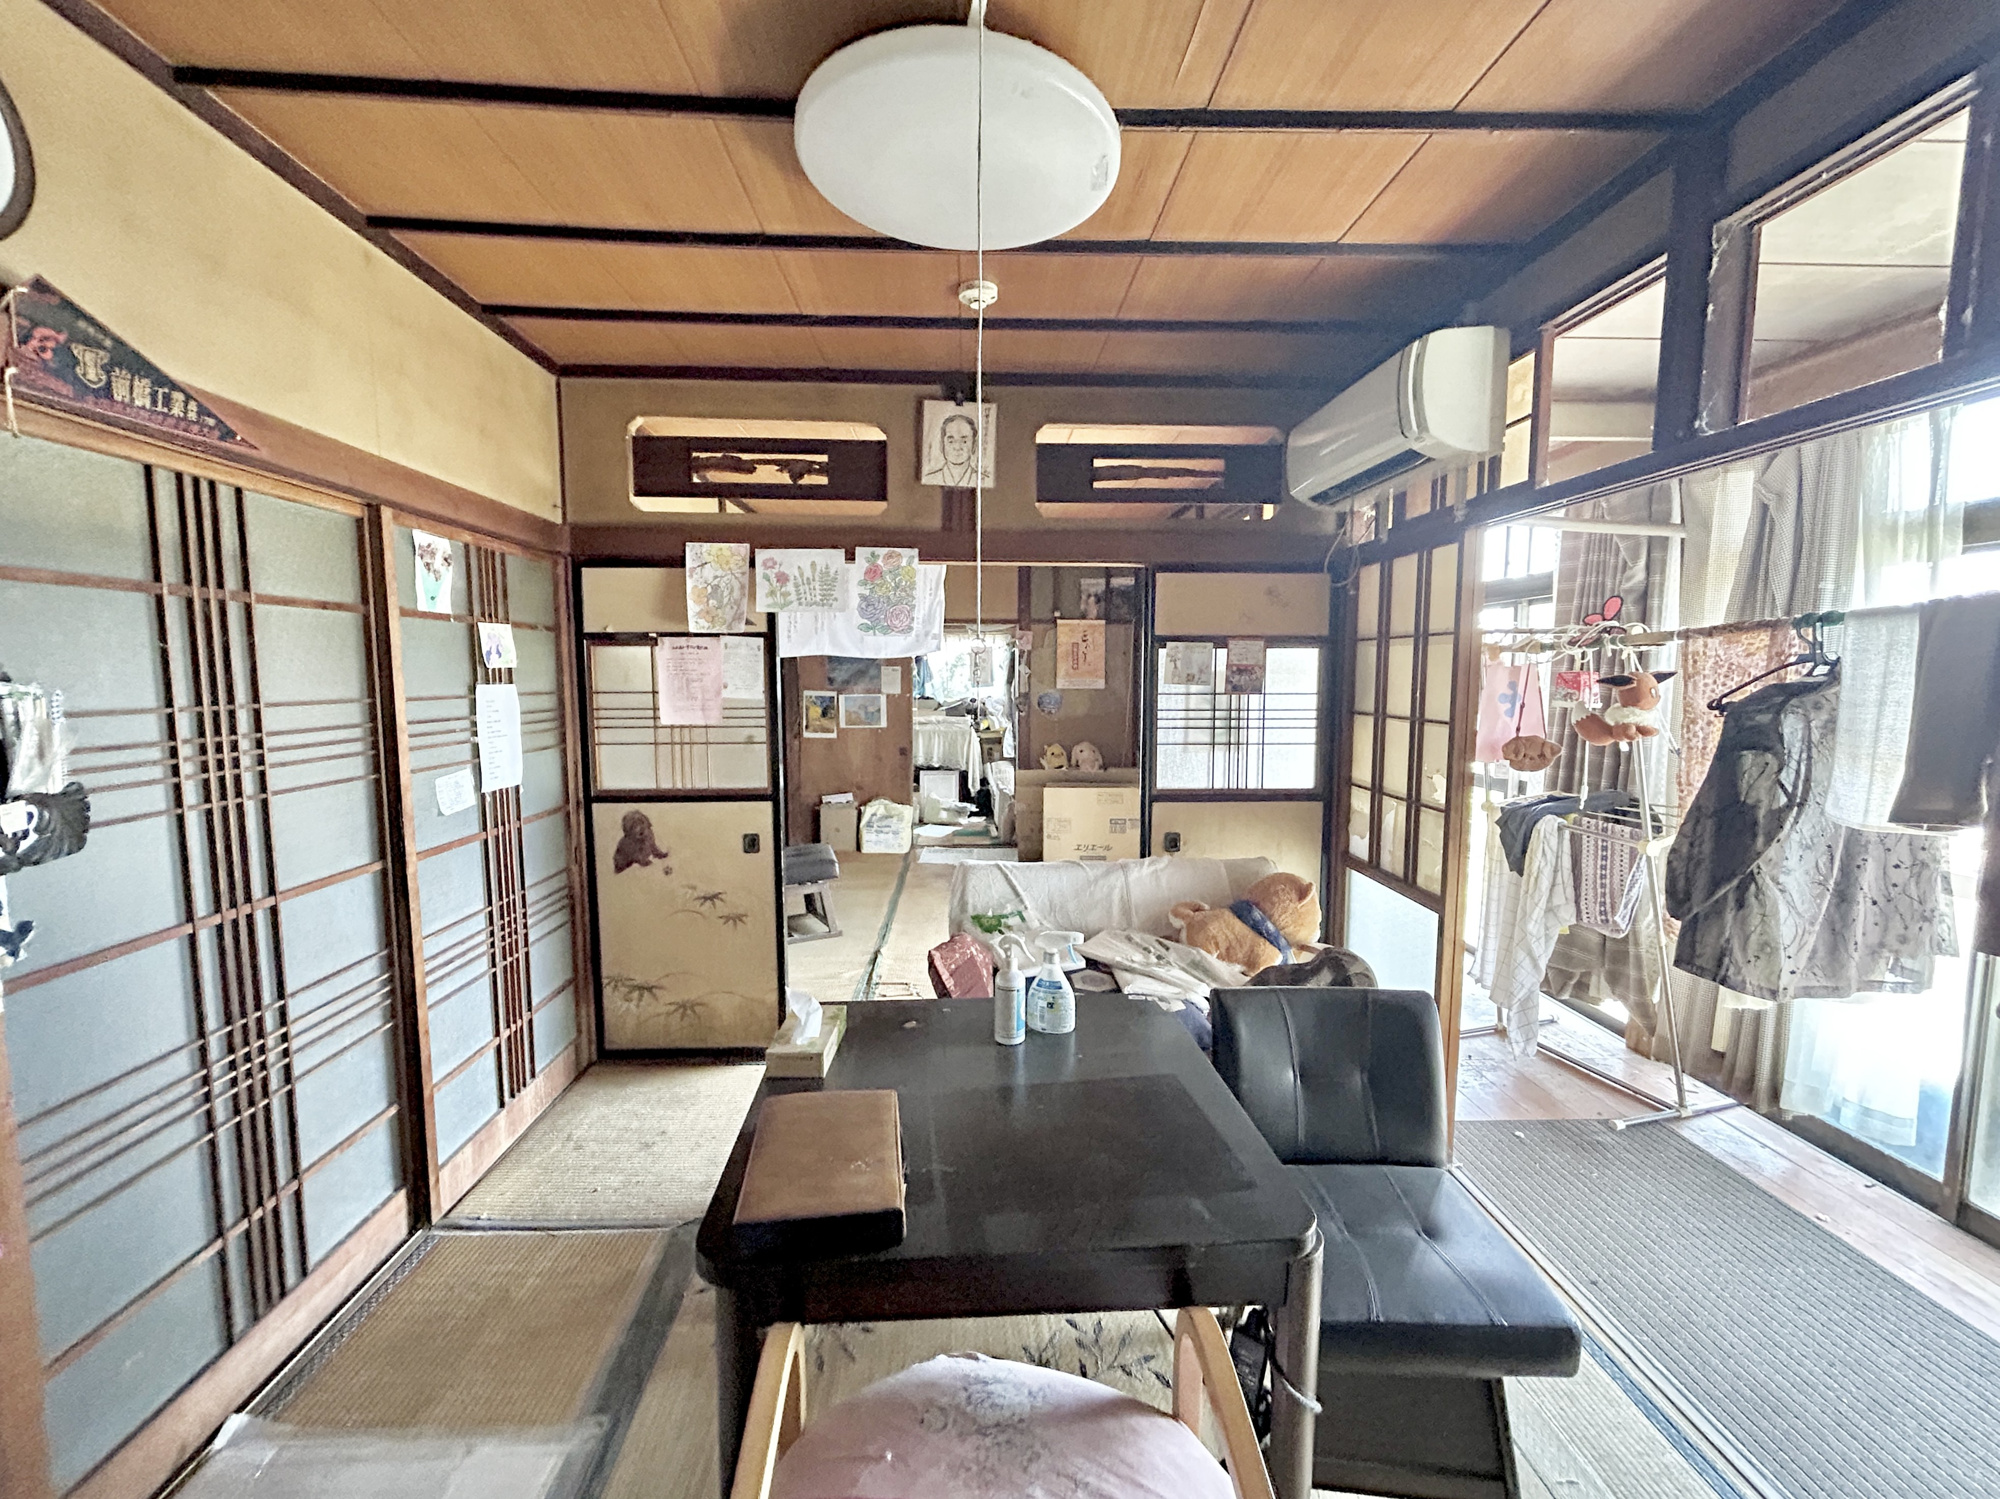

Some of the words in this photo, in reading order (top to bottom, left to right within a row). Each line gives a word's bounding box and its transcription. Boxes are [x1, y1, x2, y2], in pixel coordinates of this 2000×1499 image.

[1074, 843, 1113, 852] エリエール
